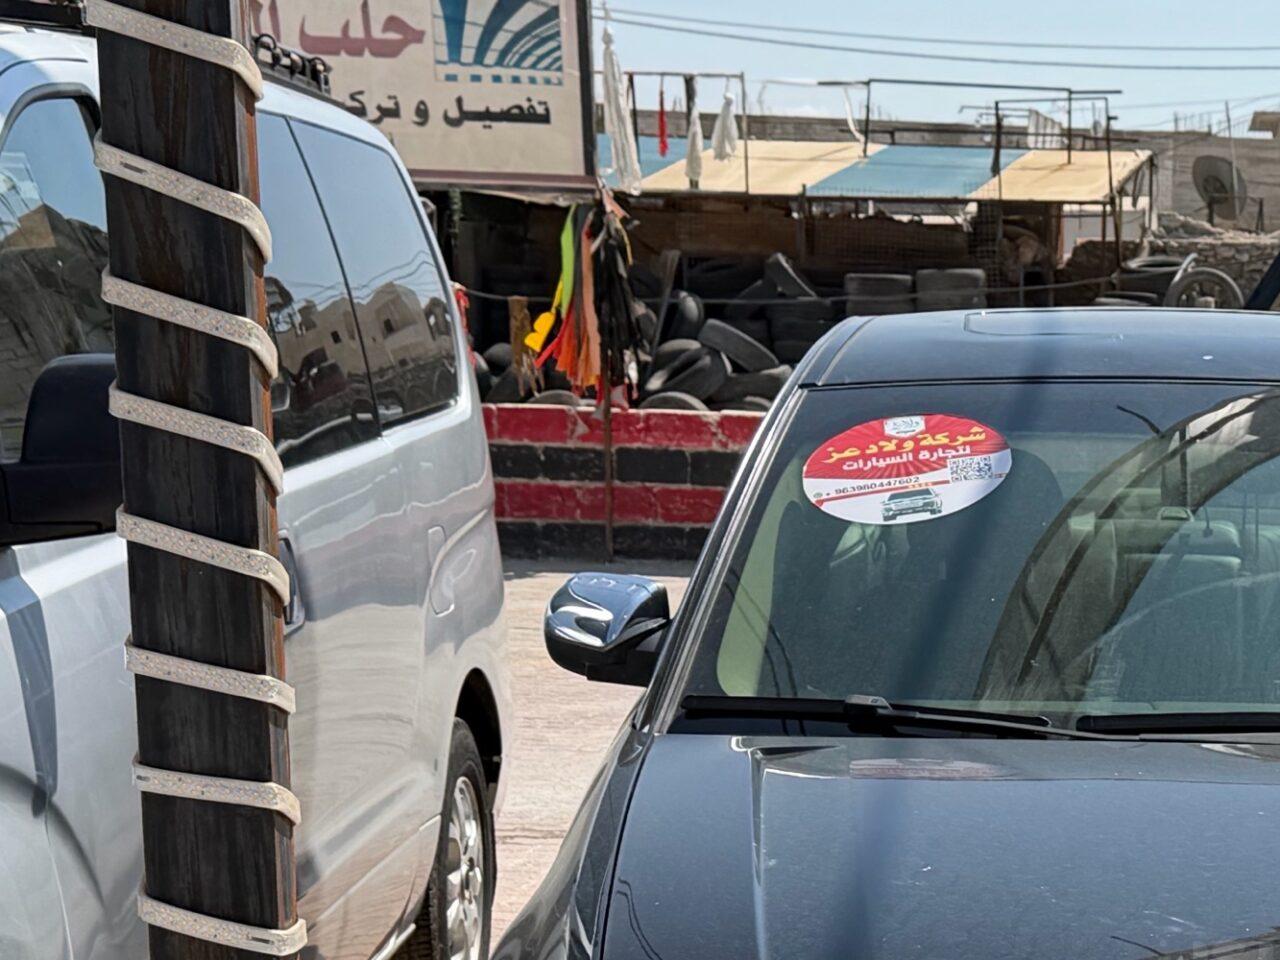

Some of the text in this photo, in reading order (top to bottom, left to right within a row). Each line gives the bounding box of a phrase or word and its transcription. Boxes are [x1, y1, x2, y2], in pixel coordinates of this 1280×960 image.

[346, 90, 552, 129] تفصيل و ترك
[916, 426, 986, 446] شركة
[842, 445, 972, 471] لتجارة السيارات
